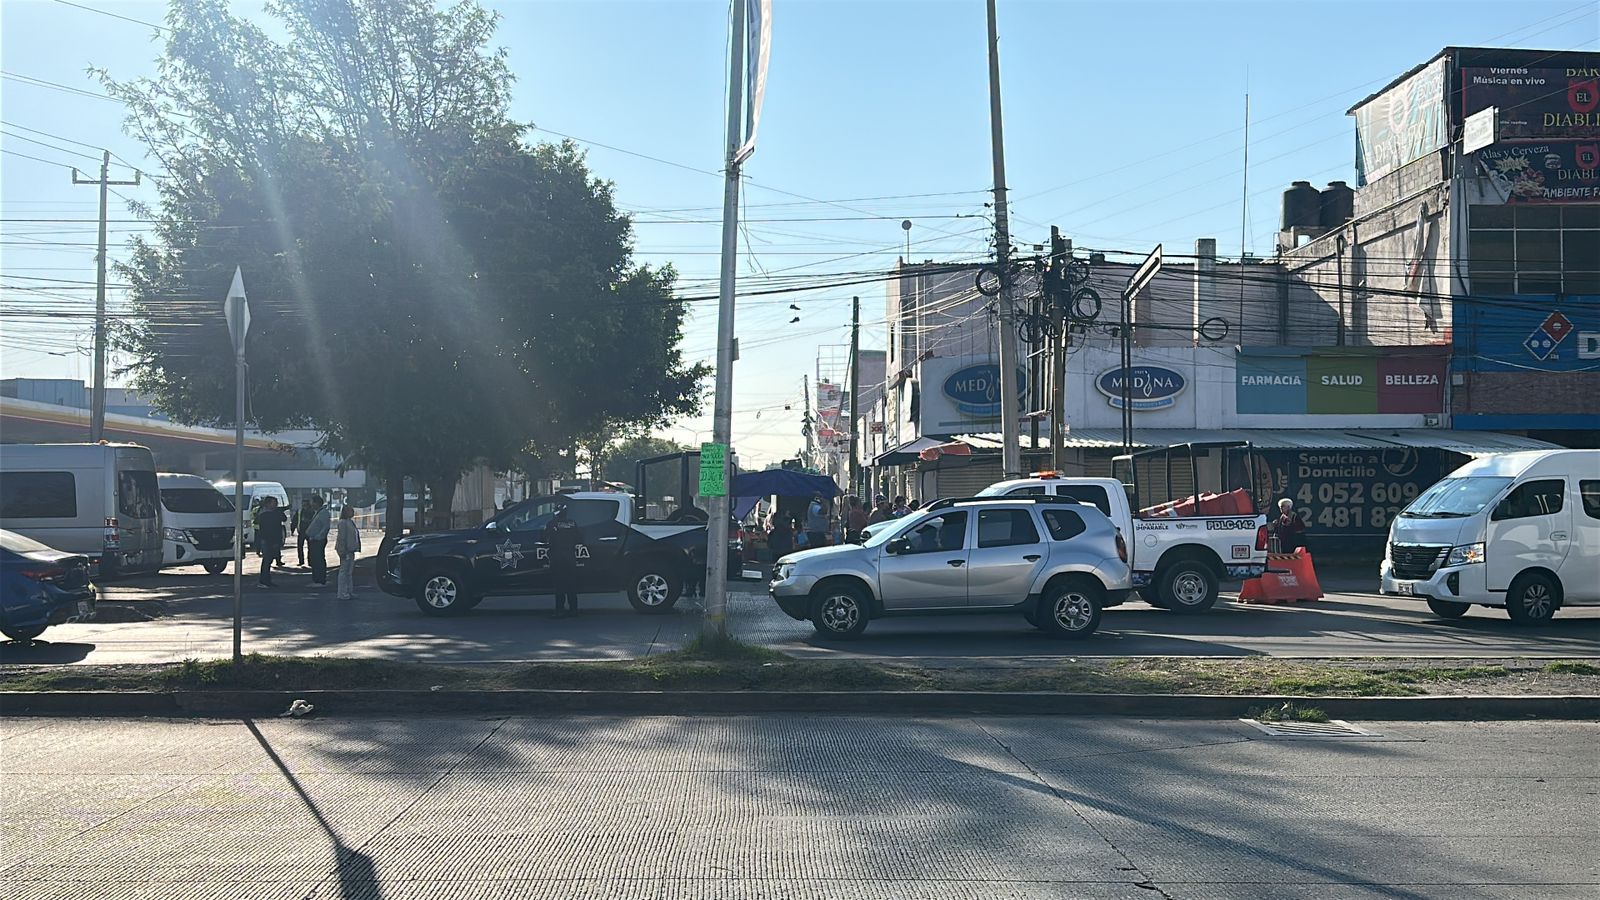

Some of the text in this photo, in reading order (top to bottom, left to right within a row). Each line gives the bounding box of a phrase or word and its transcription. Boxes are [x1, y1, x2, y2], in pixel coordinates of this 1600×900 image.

[1473, 75, 1508, 84] Música
[1525, 76, 1546, 85] vivo
[1576, 92, 1591, 102] EL
[1481, 145, 1550, 159] Alas y Cerveza
[1582, 153, 1593, 161] EL
[1543, 187, 1591, 199] AMBIENTE
[1241, 375, 1301, 386] FARMACIA
[1321, 375, 1363, 386] SALUD
[1385, 375, 1439, 386] BELLEZA
[1299, 453, 1378, 464] Servicio a
[1298, 465, 1376, 478] Domicilio
[1297, 482, 1419, 504] 4 052 609
[1318, 506, 1363, 528] 481
[1206, 520, 1256, 530] PDLC-142
